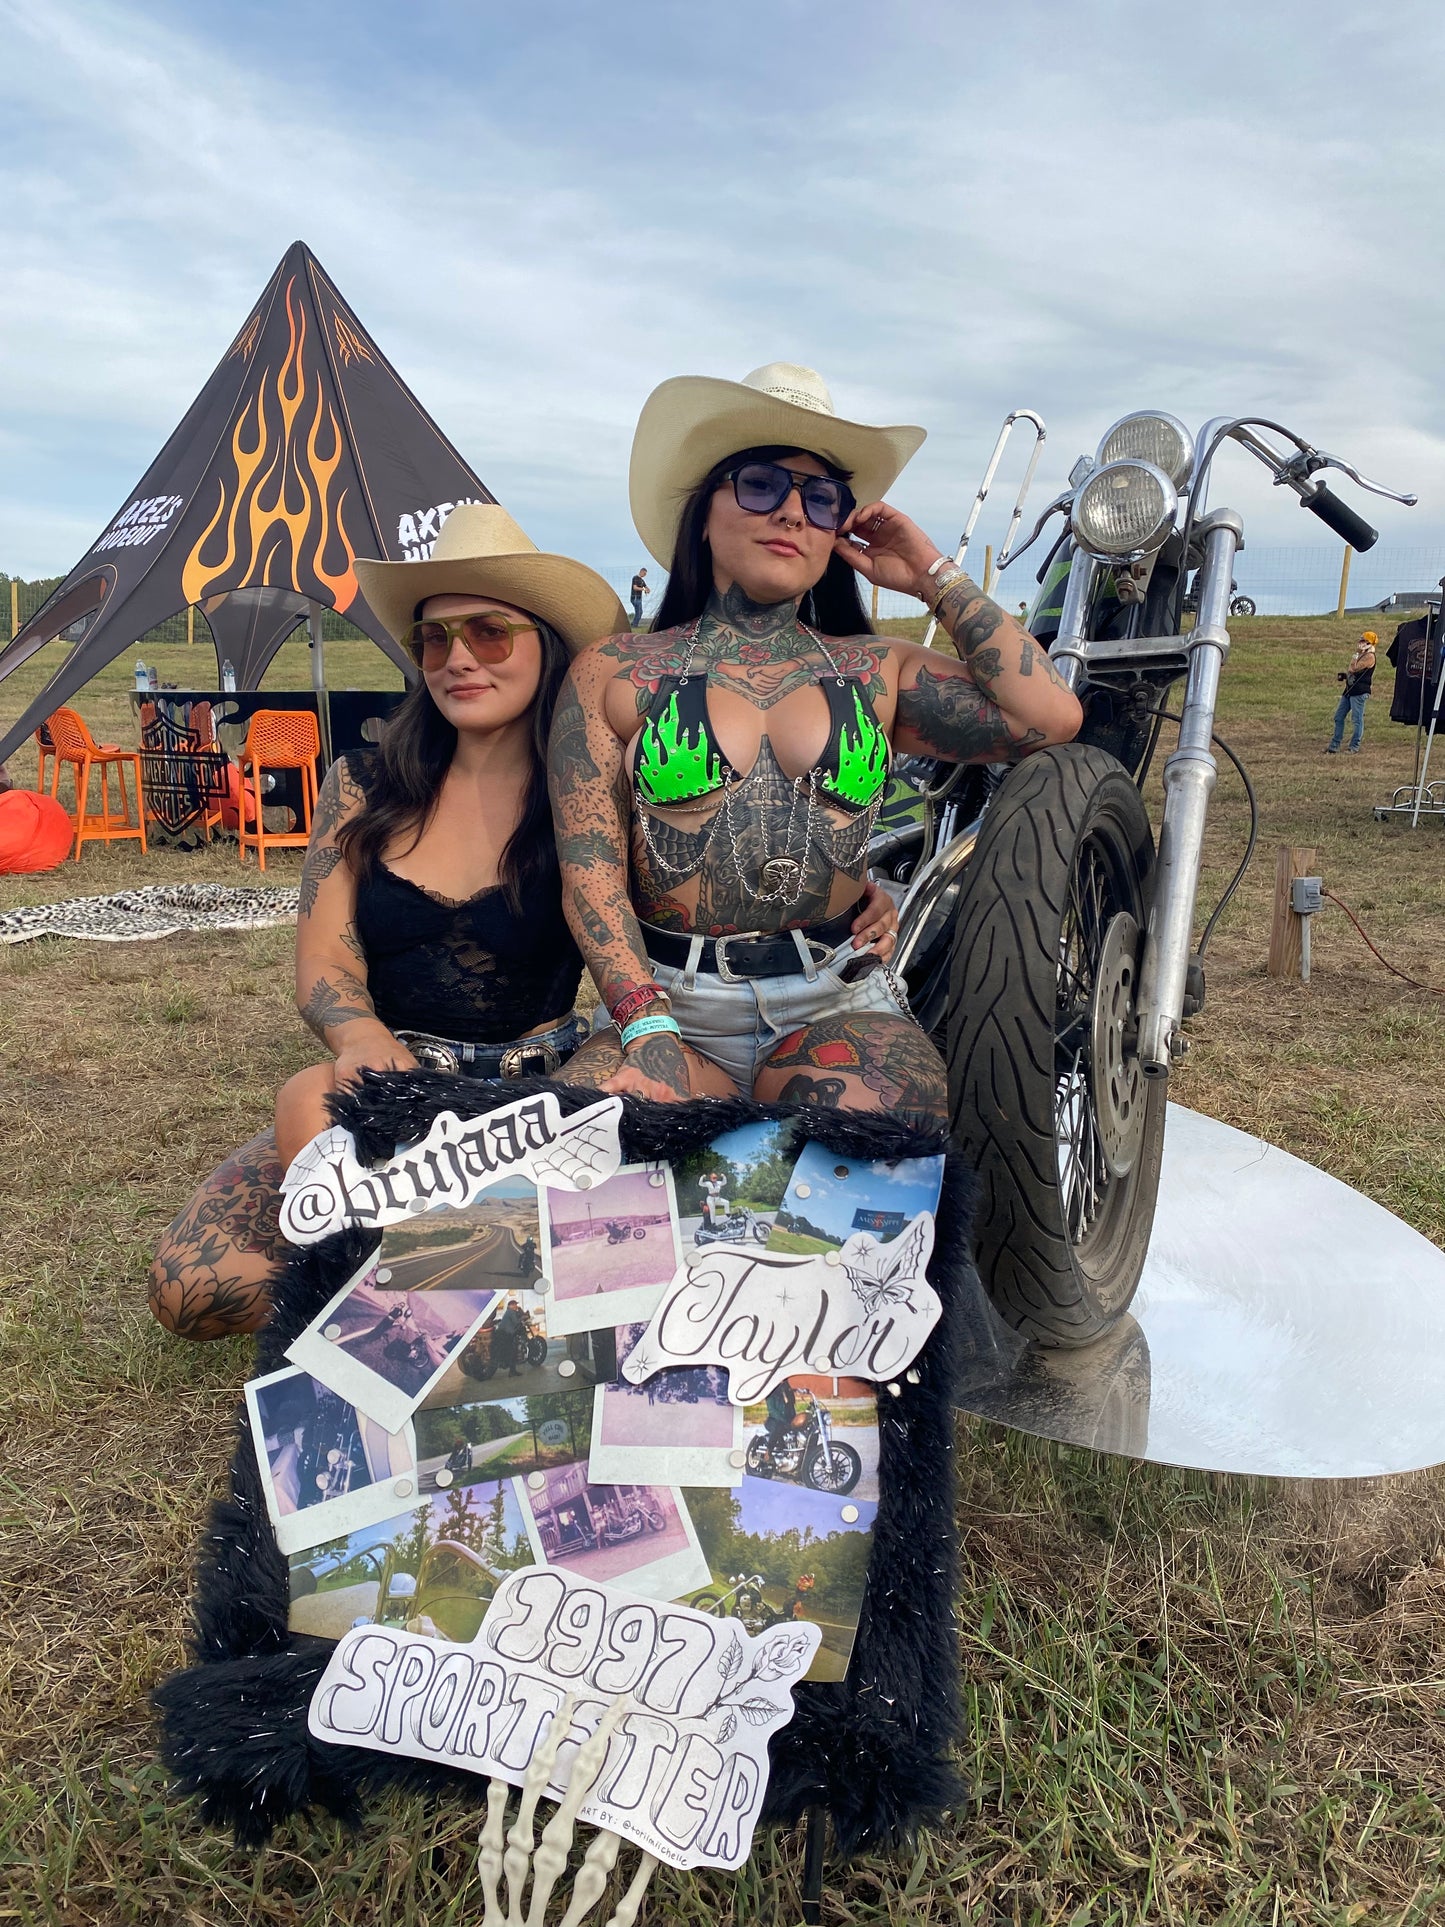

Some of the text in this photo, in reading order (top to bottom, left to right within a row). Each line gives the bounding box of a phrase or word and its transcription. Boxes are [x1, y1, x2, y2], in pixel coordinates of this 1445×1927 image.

[113, 495, 183, 530] AXEL'S
[397, 497, 483, 547] AXE
[92, 524, 168, 554] HIDEOUT
[147, 726, 189, 752] MOTOR
[153, 792, 192, 825] CYCLES
[288, 1099, 556, 1234] @brujaaa
[657, 1251, 909, 1401] Taylor
[487, 1573, 716, 1715] 1997
[317, 1635, 759, 1861] SPORTSTER
[580, 1806, 598, 1815] ART
[600, 1811, 618, 1824] BY:
